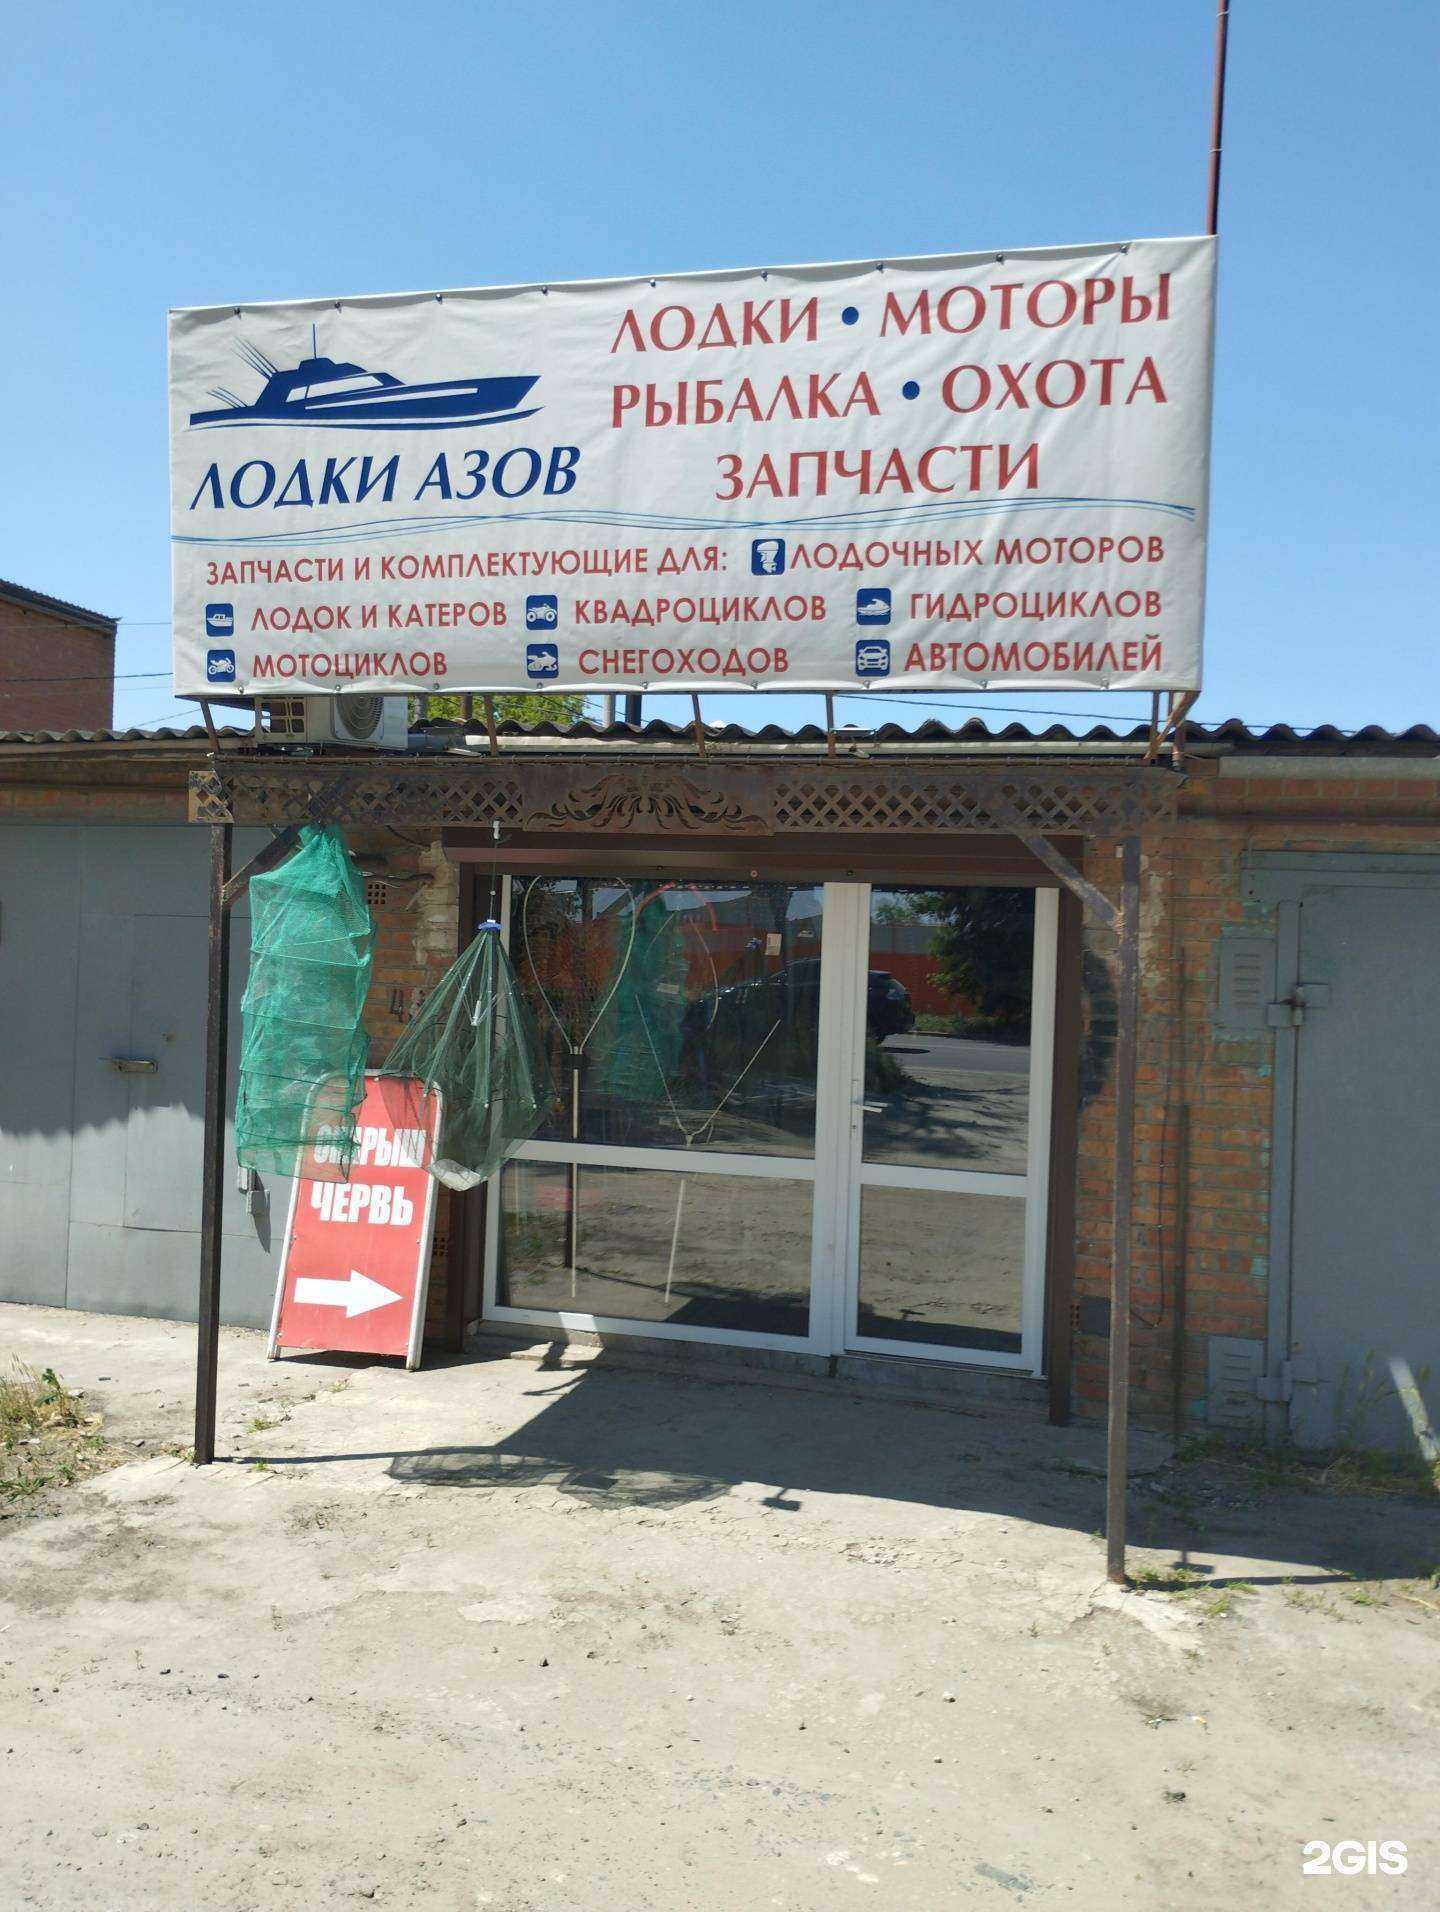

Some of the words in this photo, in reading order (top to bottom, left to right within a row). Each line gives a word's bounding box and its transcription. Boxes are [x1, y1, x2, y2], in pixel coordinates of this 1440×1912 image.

[611, 297, 818, 353] ЛОДКИ
[880, 273, 1171, 337] МОТОРЫ
[612, 371, 881, 429] РЫБАЛКА
[942, 356, 1168, 413] ОХОТА
[189, 454, 400, 510] ЛОДКИ
[414, 446, 581, 501] АЗОВ
[715, 442, 1040, 500] ЗАПЧАСТИ
[206, 558, 344, 586] ЗАПЧАСТИ
[354, 558, 371, 582] И
[381, 547, 648, 579] КОМПЛЕКТУЮЩИЕ
[657, 545, 728, 576] ДЛЯ:
[791, 540, 983, 571] ЛОДОЧНЫХ
[994, 535, 1165, 566] МОТОРОВ
[251, 605, 351, 633] ЛОДОК
[361, 605, 377, 629] И
[388, 602, 508, 628] КАТЕРОВ
[574, 595, 827, 627] КВАДРОЦИКЛОВ
[910, 590, 1162, 623] ГИДРОЦИКЛОВ
[253, 651, 448, 679] МОТОЦИКЛОВ
[578, 647, 790, 677] СНЕГОХОДОВ
[903, 634, 1162, 673] АВТОМОБИЛЕЙ
[310, 1181, 414, 1226] ЧЕРВЬ
